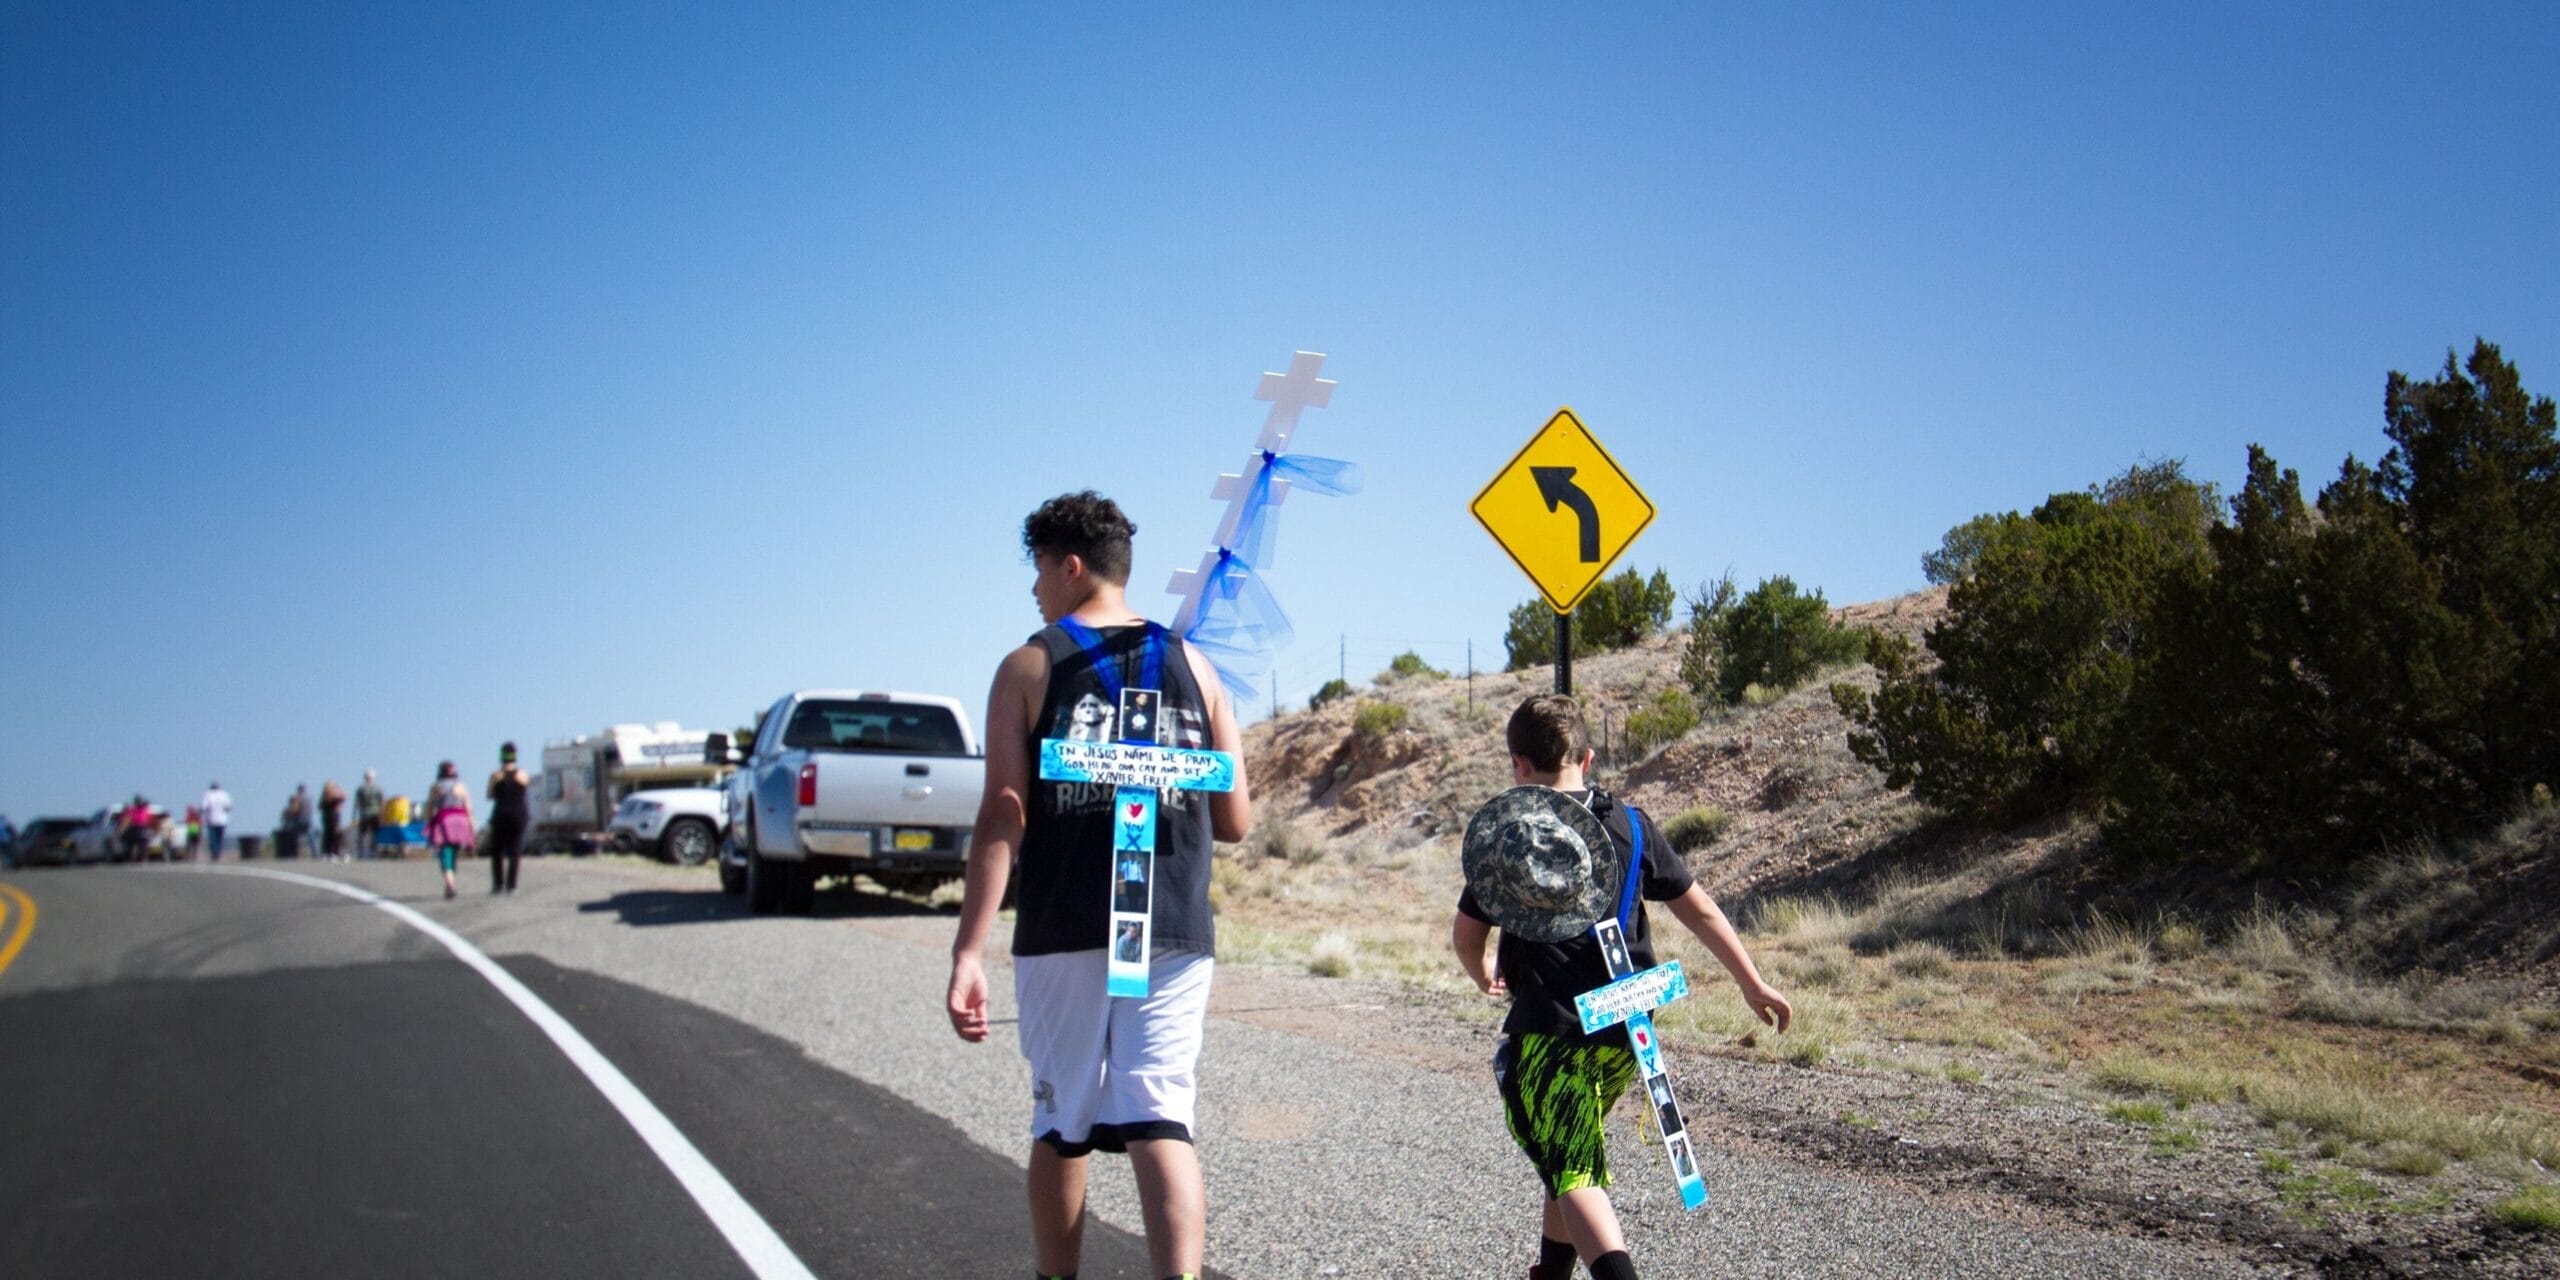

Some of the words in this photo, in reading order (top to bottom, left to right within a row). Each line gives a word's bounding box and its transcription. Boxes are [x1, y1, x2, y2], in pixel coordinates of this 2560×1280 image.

[1059, 745, 1076, 756] IN
[1083, 745, 1118, 760] JESUS
[1124, 748, 1153, 762] NAME
[1161, 752, 1176, 763] WE
[1185, 754, 1212, 767] PRAY
[1064, 760, 1085, 769] GOD
[1118, 763, 1136, 773] OUR
[1161, 766, 1180, 774] AND
[1096, 771, 1136, 785] XAVIER
[1143, 774, 1169, 787] FREE
